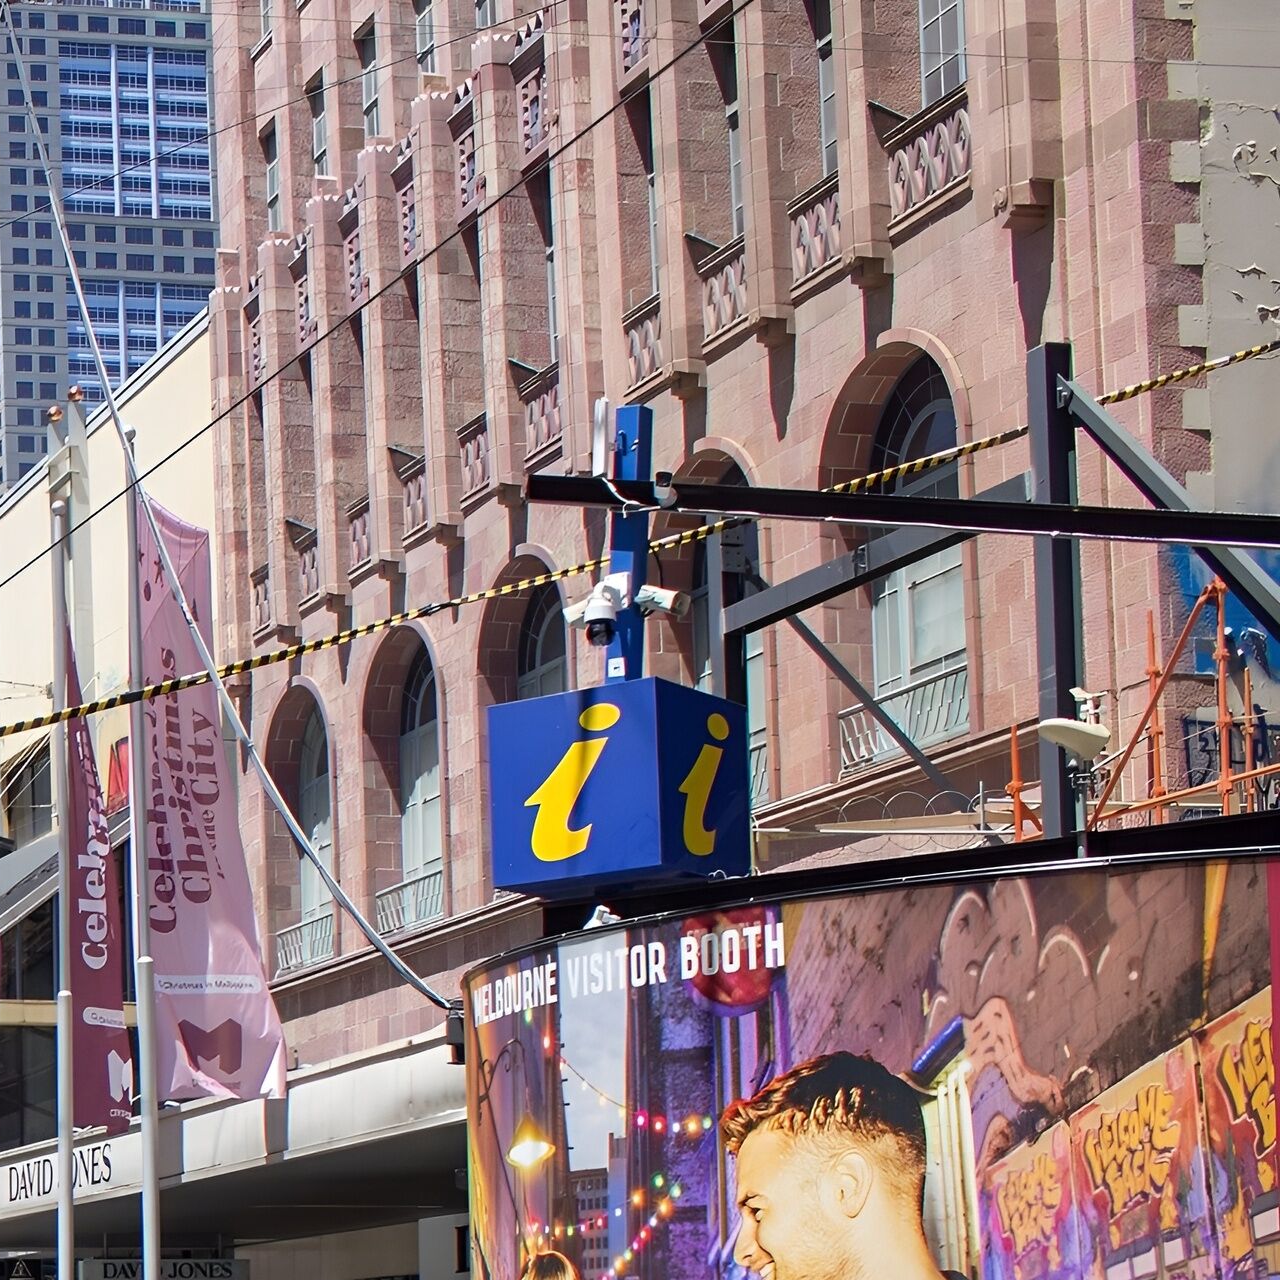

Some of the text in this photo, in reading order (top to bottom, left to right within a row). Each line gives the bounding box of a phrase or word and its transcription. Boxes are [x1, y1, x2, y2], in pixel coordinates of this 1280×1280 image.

[185, 706, 220, 806] City
[474, 922, 785, 1027] MELBOURNE VISITOR BOOTH
[8, 1158, 53, 1202] DAVID
[168, 1262, 233, 1279] JONES
